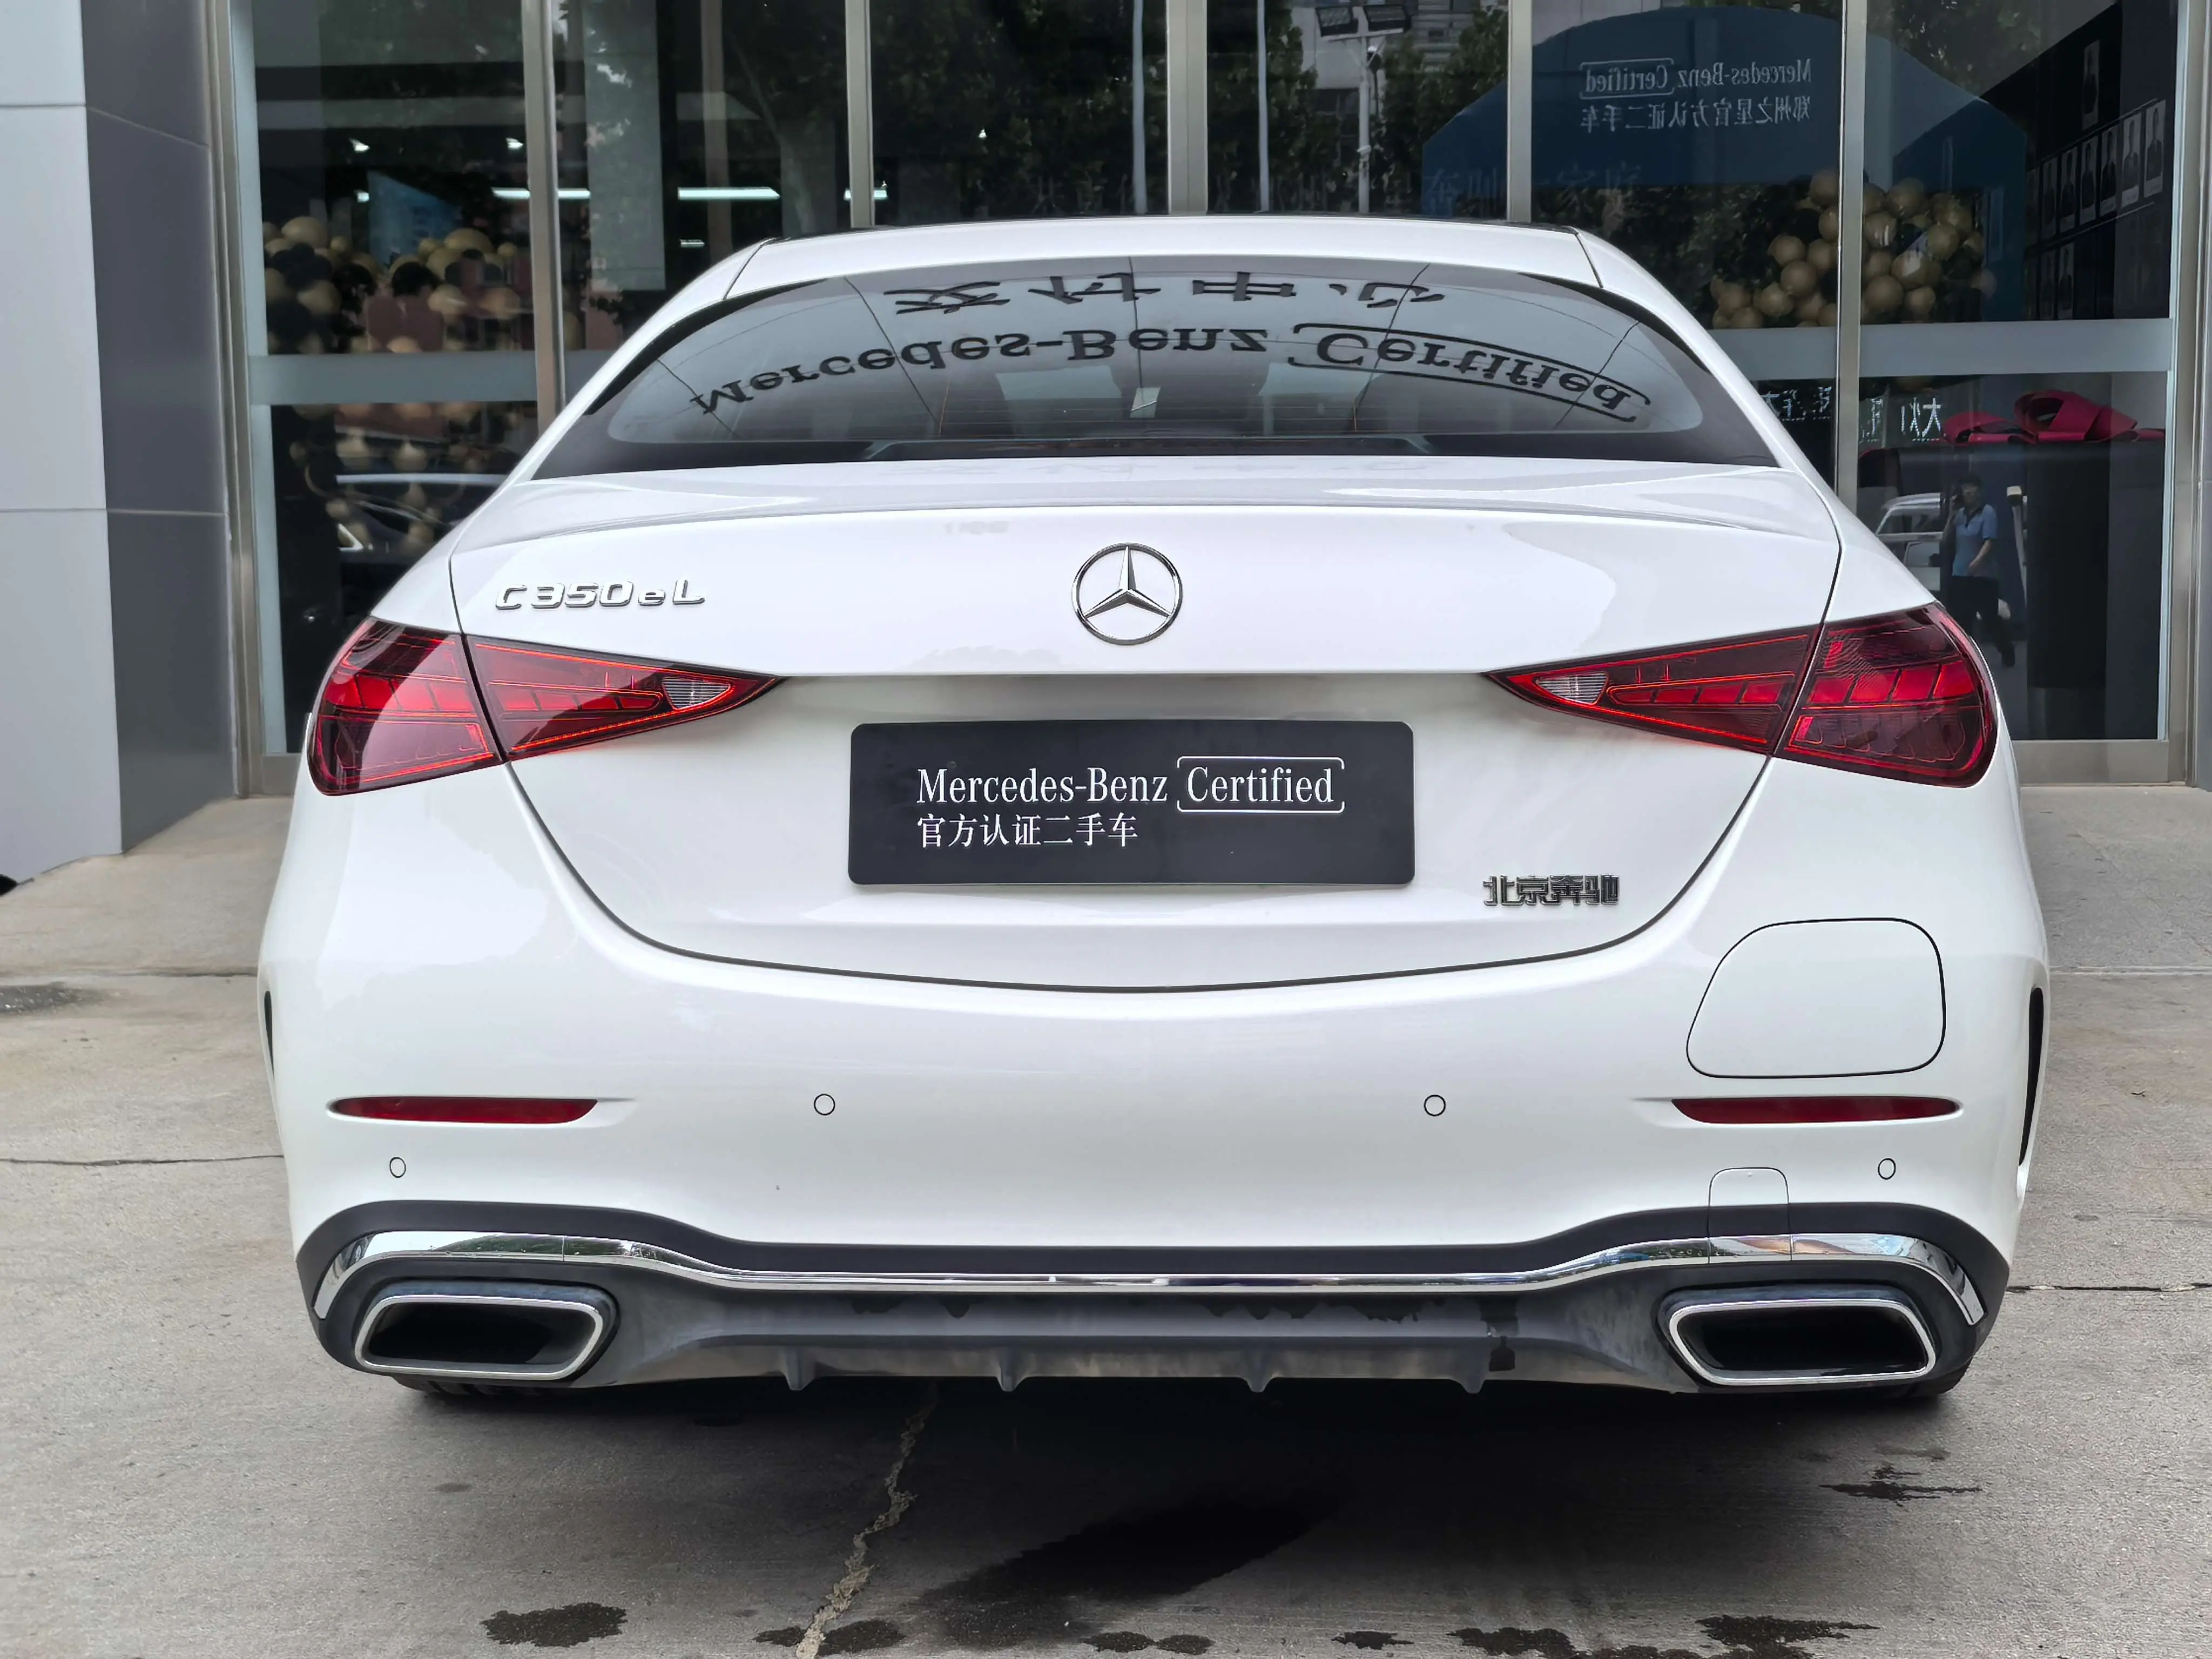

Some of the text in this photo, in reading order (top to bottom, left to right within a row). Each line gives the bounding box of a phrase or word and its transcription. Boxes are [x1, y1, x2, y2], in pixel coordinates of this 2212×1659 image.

[916, 766, 1334, 805] Mercedes-Benz Certified
[916, 813, 1139, 848] 官方认证二手车
[1482, 874, 1620, 906] 北京奔驰
